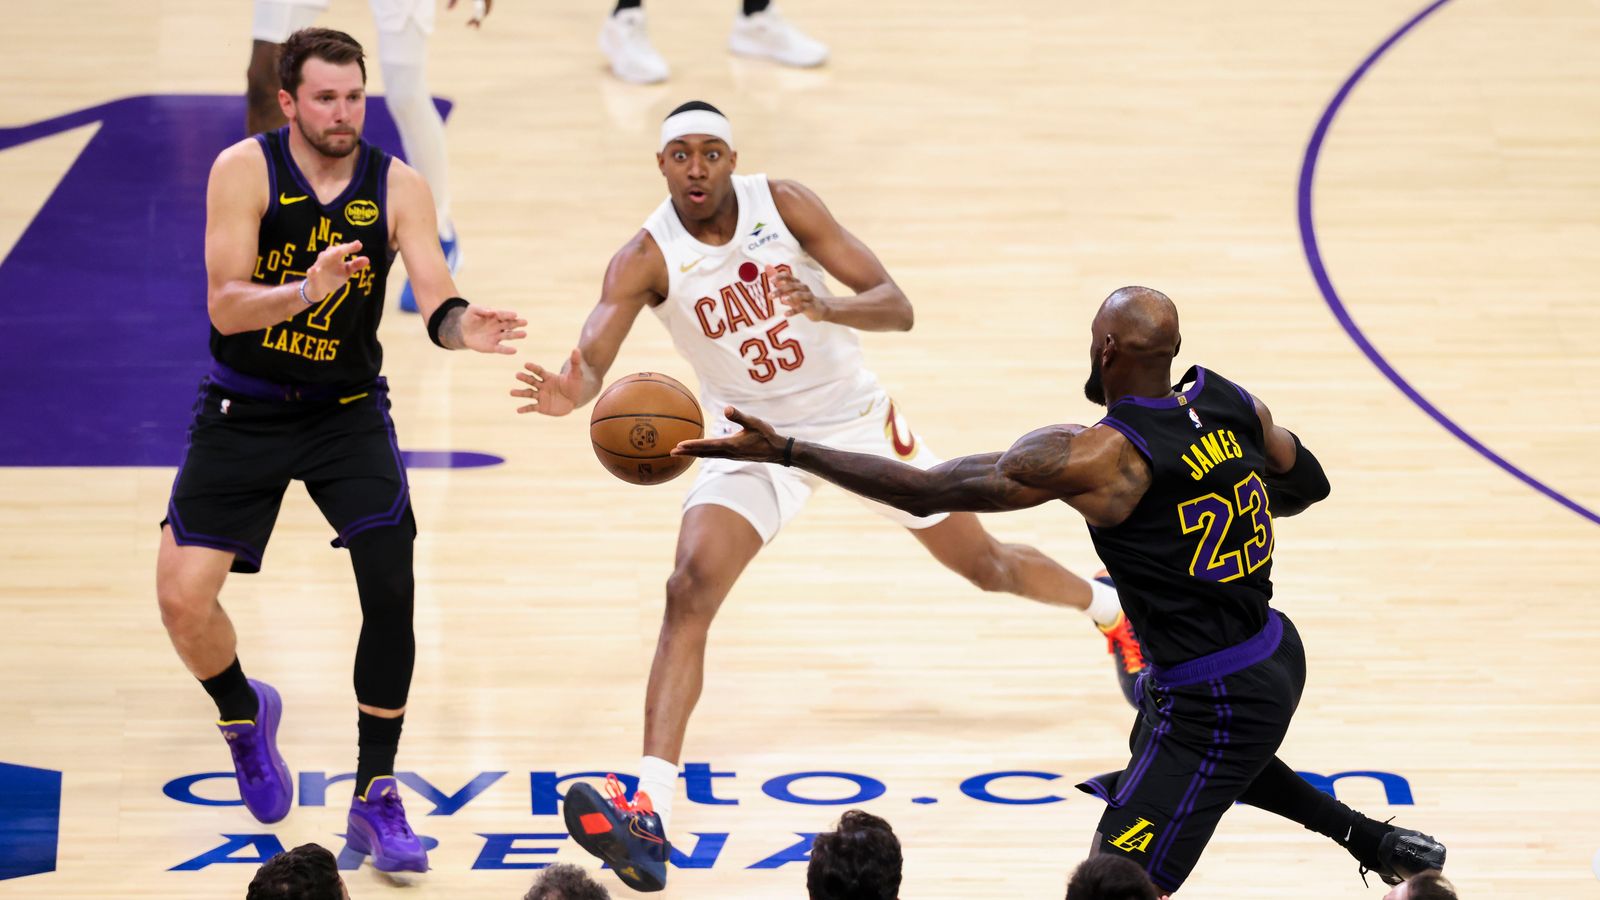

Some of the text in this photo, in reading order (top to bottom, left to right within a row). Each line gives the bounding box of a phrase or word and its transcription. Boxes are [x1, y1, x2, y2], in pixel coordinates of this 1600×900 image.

[348, 206, 376, 219] bibigo
[254, 217, 375, 296] LOS ANGES
[262, 326, 340, 361] LAKERS
[739, 320, 805, 384] 35
[1181, 429, 1243, 481] JAMES
[1177, 470, 1275, 583] 23
[162, 763, 1415, 816] crypto.cm
